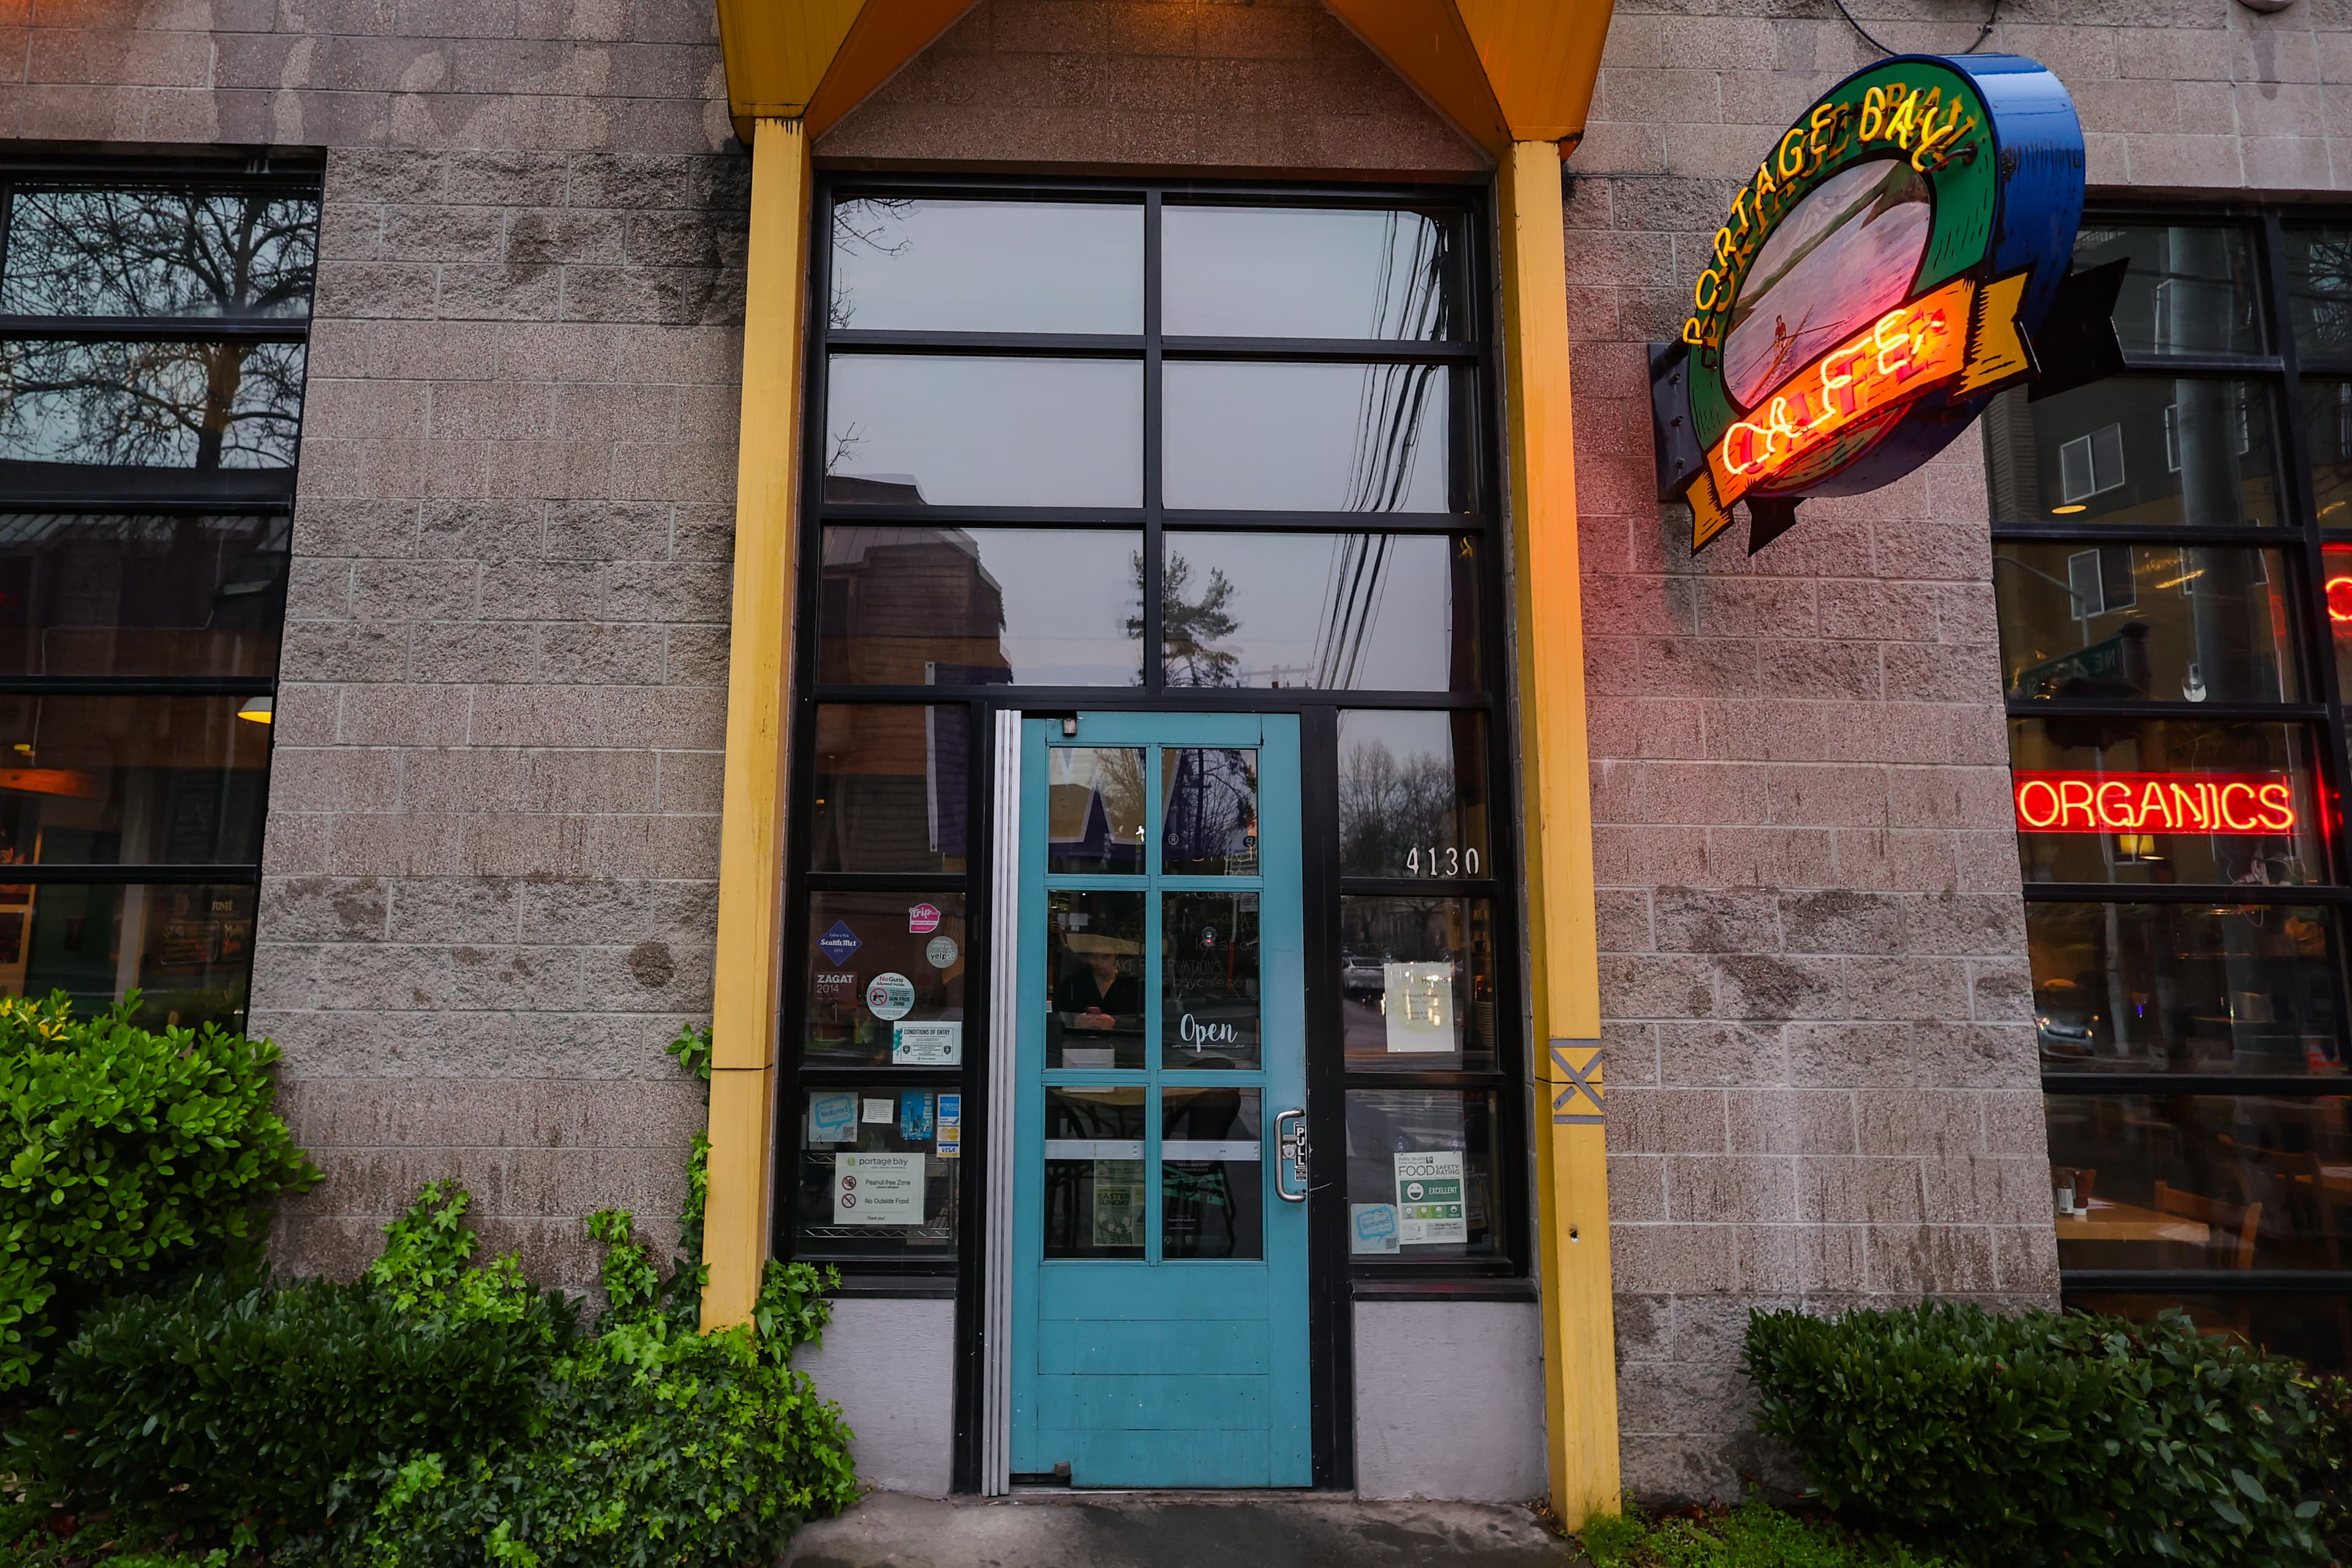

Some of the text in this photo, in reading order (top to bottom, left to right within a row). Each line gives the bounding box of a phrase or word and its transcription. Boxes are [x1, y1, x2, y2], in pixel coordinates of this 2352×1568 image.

[1683, 84, 1973, 350] PORTAGE BAY
[2018, 780, 2294, 830] ORGANICS
[1406, 847, 1479, 876] 4130
[816, 984, 839, 993] 2014
[817, 974, 854, 984] ZAGAT
[1180, 1012, 1238, 1053] Open
[1296, 1126, 1305, 1166] PULL
[893, 1157, 908, 1166] bay
[1398, 1165, 1435, 1177] FOOD
[1428, 1186, 1458, 1195] EXCELLENT
